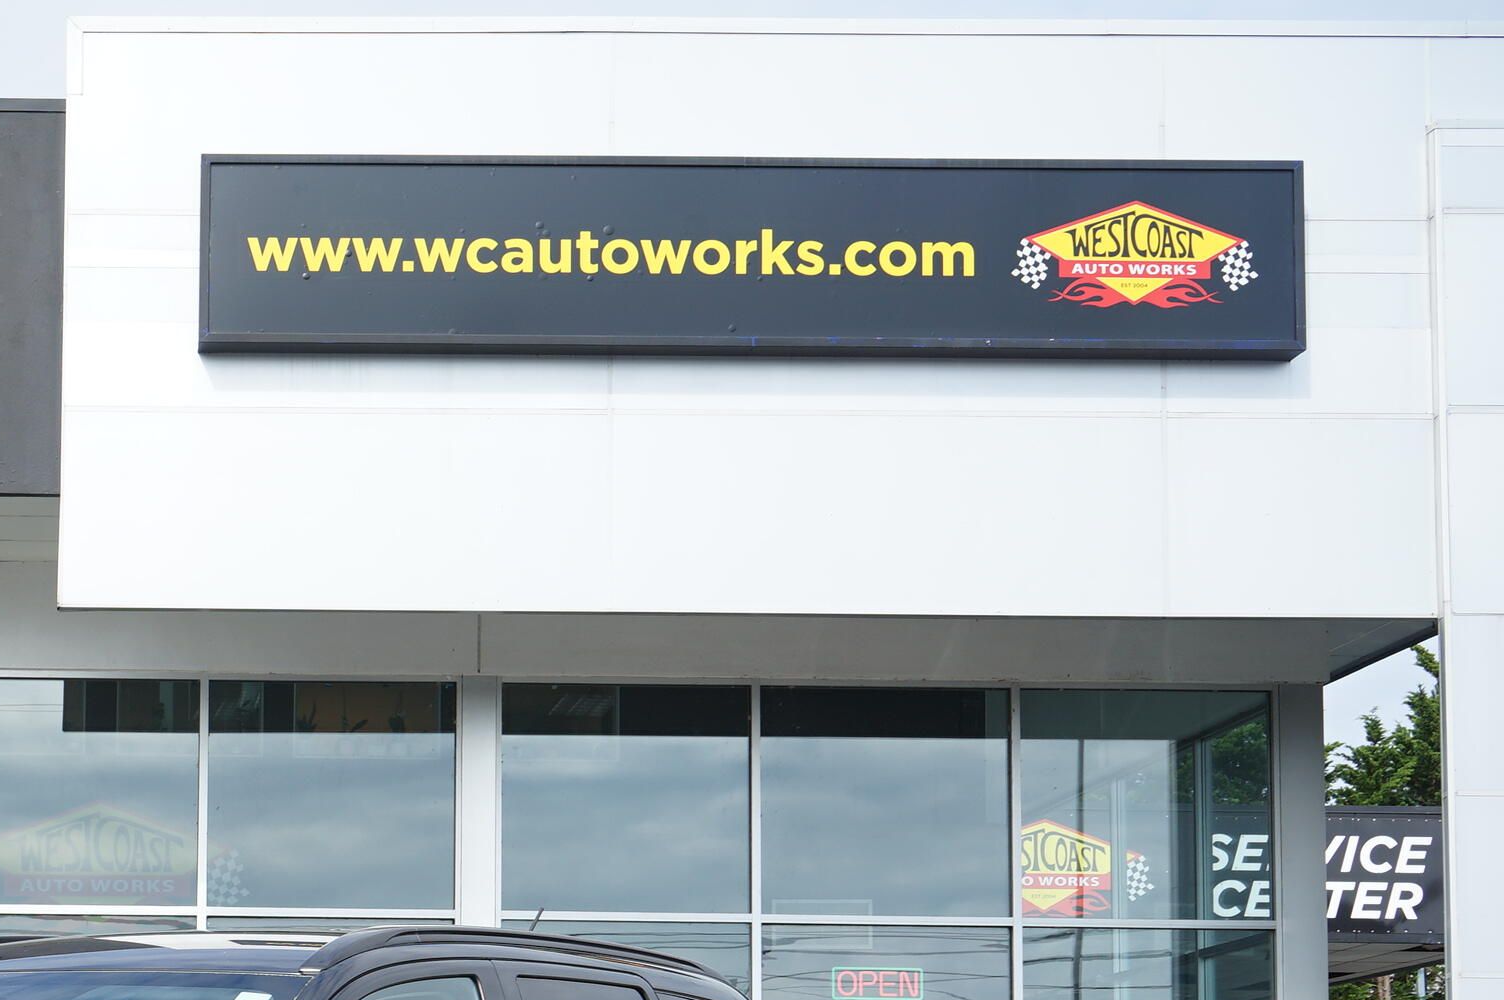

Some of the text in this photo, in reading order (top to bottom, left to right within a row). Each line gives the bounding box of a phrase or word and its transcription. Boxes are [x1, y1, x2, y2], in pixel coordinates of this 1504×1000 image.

[248, 229, 975, 277] www.wcautoworks.com
[1071, 263, 1197, 276] AUTO WORKS
[1212, 833, 1433, 874] SEICE
[19, 878, 176, 894] AUTO WORKS
[1038, 876, 1100, 887] WORKS
[1212, 879, 1424, 920] CETER
[837, 970, 919, 997] OPEN
